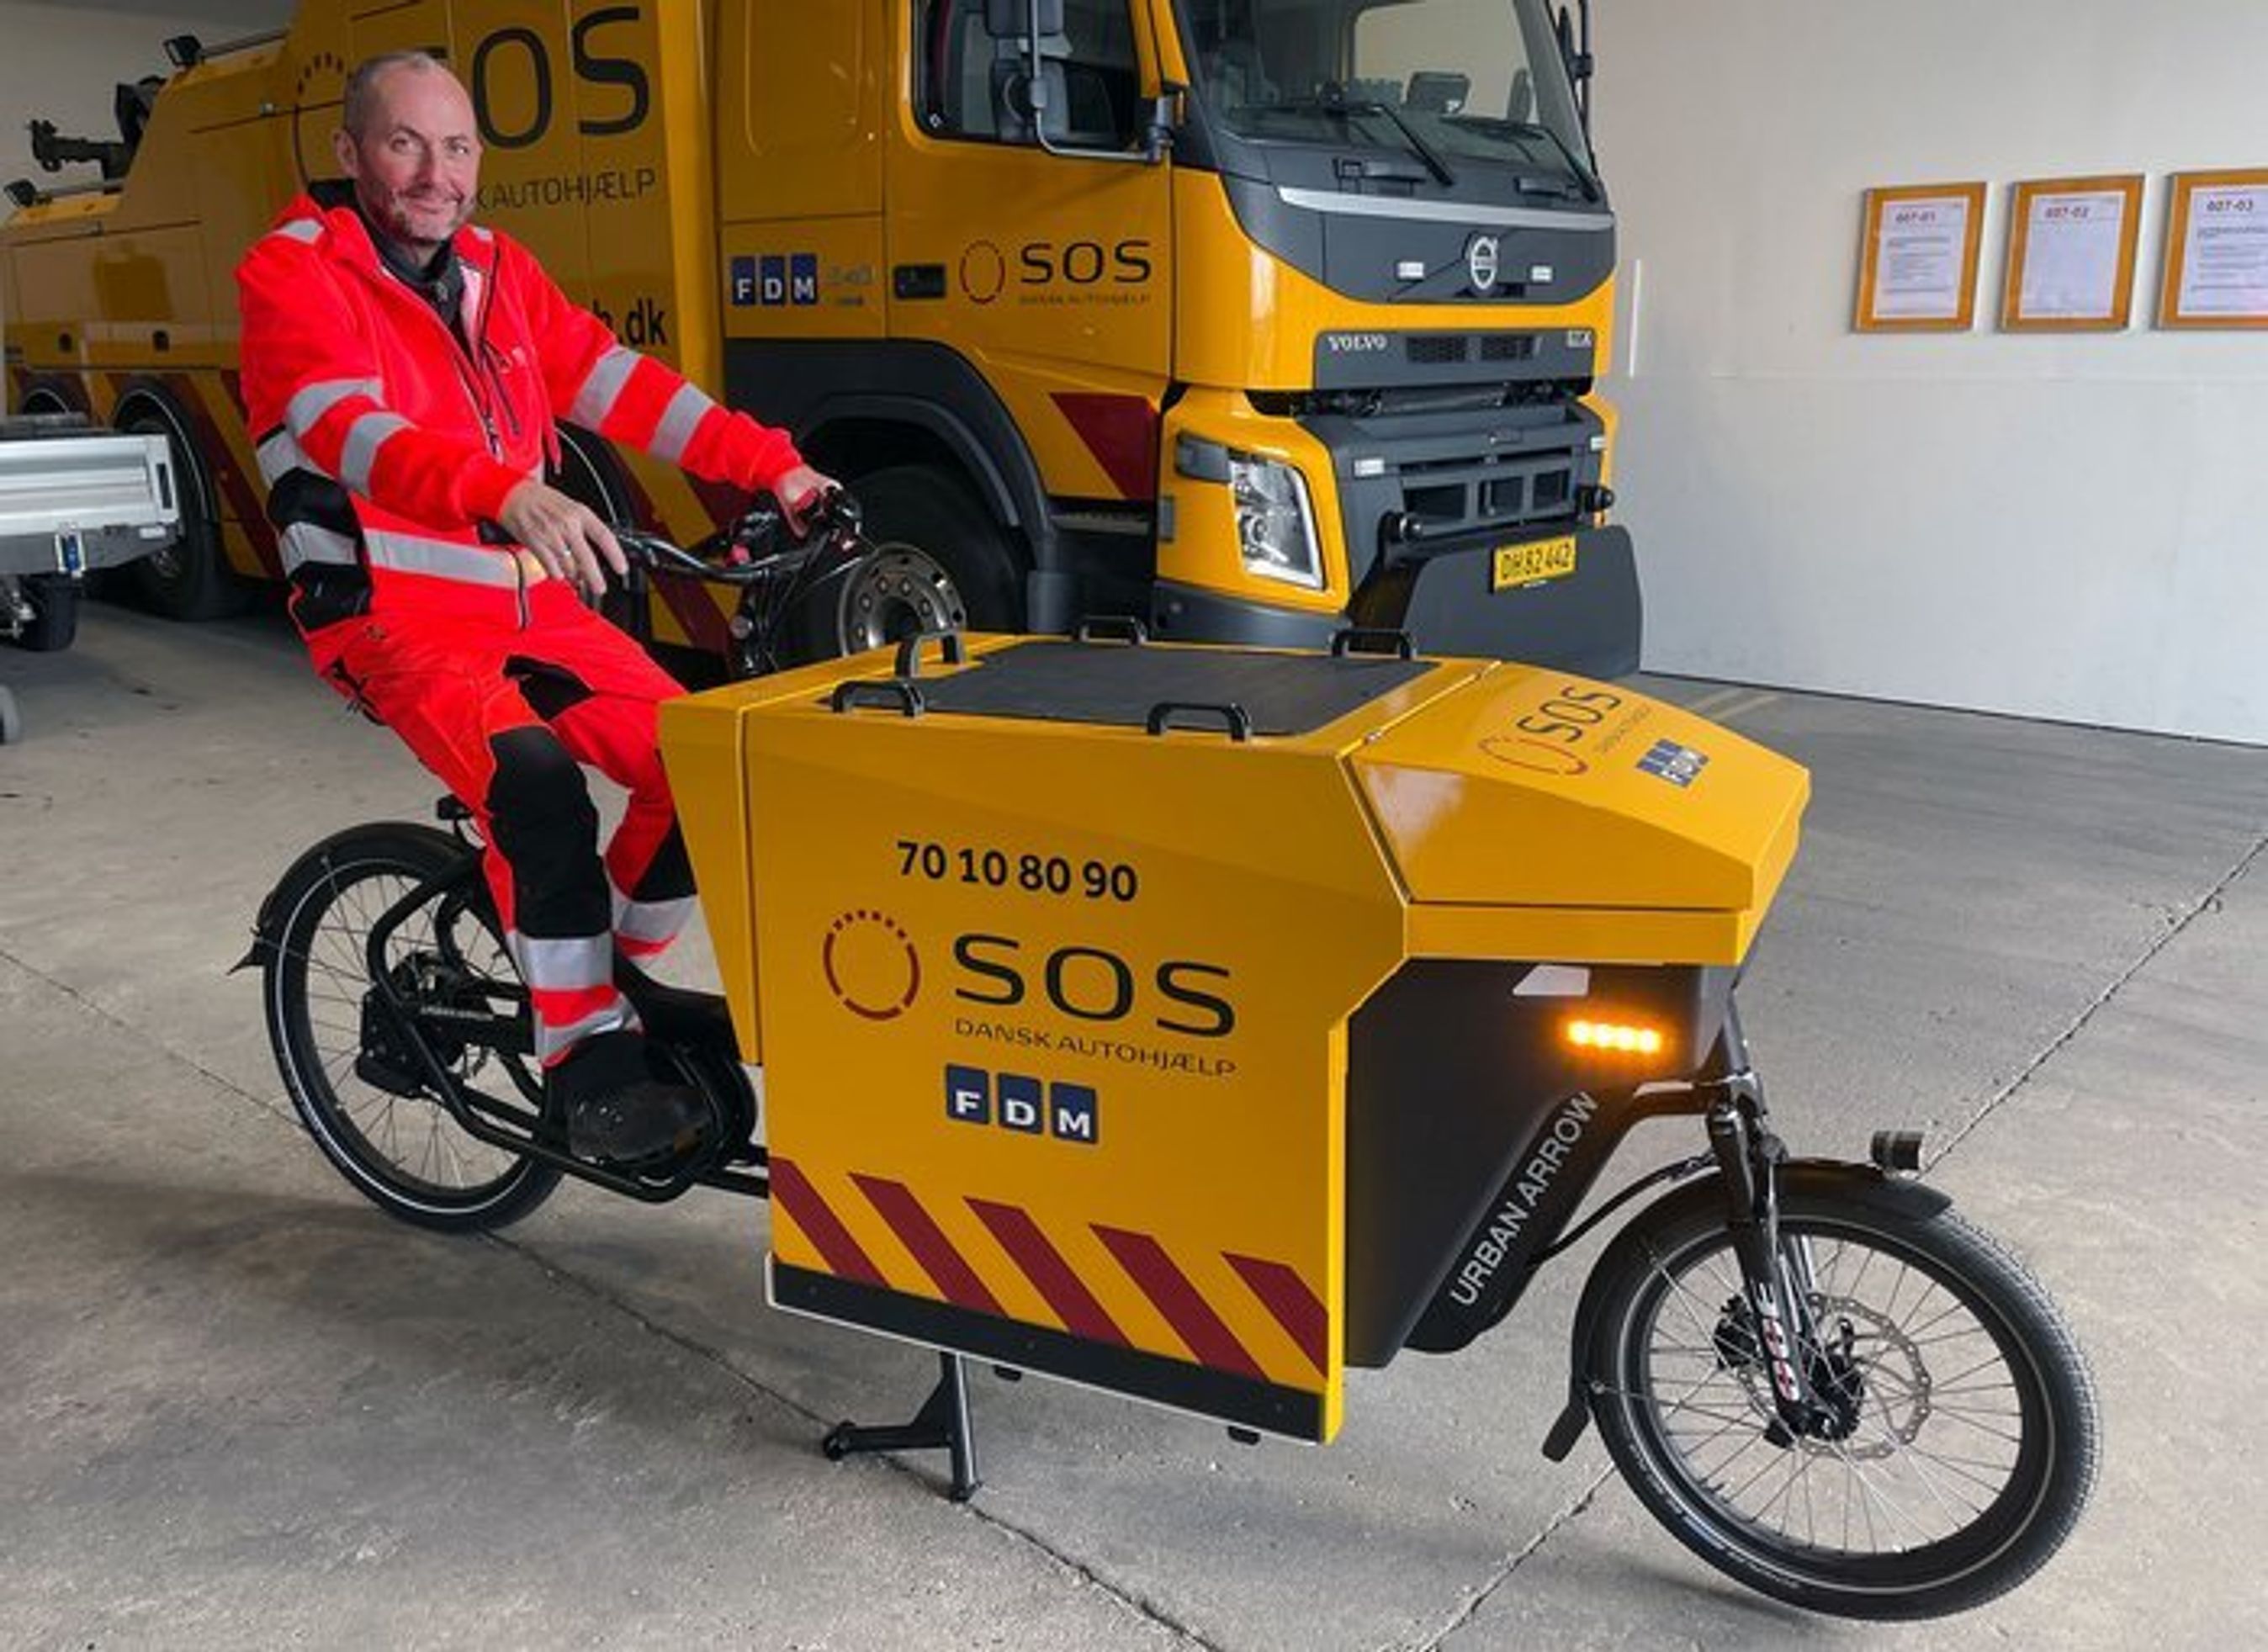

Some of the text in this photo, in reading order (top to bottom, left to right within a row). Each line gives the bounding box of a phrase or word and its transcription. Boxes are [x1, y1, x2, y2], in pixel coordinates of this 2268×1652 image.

[422, 7, 649, 148] OS
[493, 168, 655, 209] AUTOHJÆLP
[1020, 240, 1152, 283] SOS
[1327, 334, 1387, 351] VOLVO
[1517, 686, 1621, 743] SOS
[898, 841, 1137, 902] 70 10 80 90
[953, 933, 1237, 1038] SOS
[956, 1019, 1237, 1077] DANSK AUTOHJÆLP
[1449, 1092, 1598, 1305] URBAN ARROW
